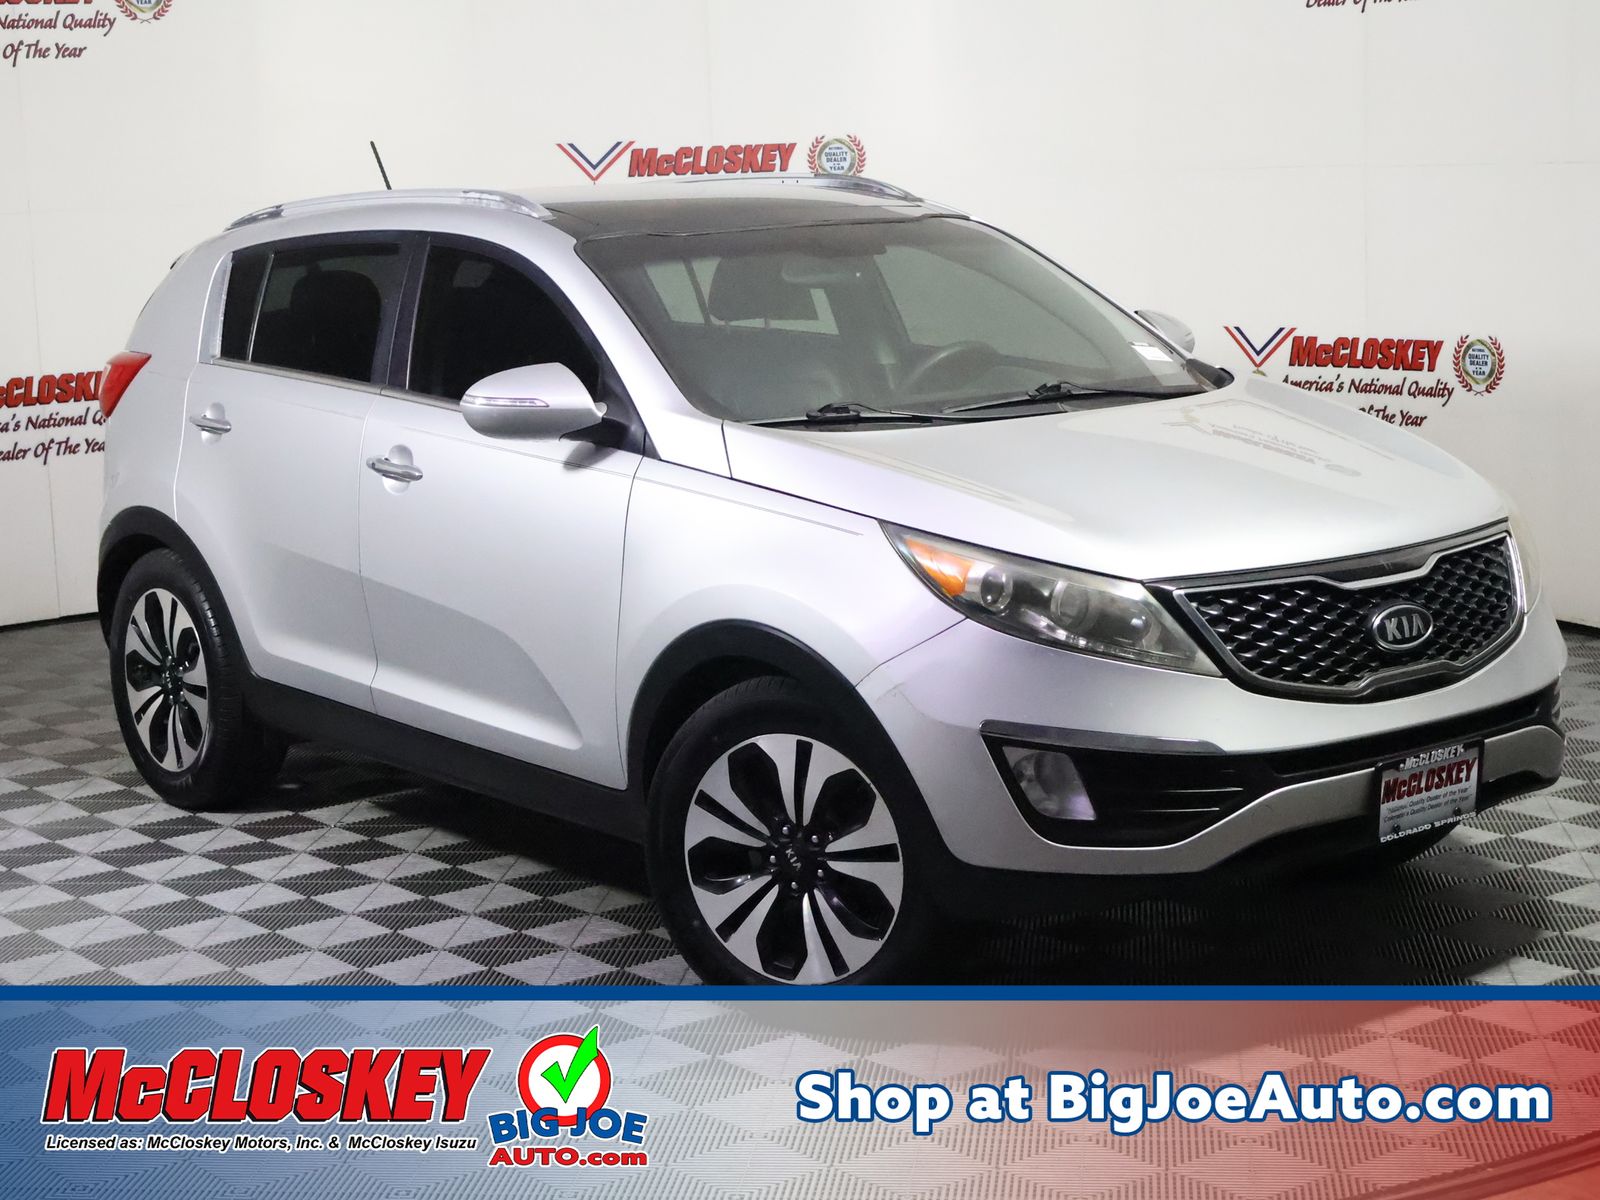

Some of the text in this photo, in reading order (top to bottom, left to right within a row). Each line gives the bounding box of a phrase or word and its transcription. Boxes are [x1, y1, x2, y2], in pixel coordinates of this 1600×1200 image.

[63, 10, 116, 37] Quality
[3, 40, 87, 67] Of The Year
[628, 142, 798, 177] McCLOSKEY
[1289, 336, 1443, 372] McCLOSKEY
[1348, 377, 1407, 395] National
[1408, 379, 1455, 407] Quality
[25, 407, 90, 431] National
[1400, 410, 1427, 427] Year
[34, 438, 55, 465] Of
[55, 437, 81, 456] The
[84, 438, 105, 454] Yea
[1384, 613, 1426, 641] KIA
[1404, 744, 1464, 770] McCLOSKEY
[1381, 757, 1478, 805] McCLOSKEY
[1380, 823, 1432, 843] COLORADO
